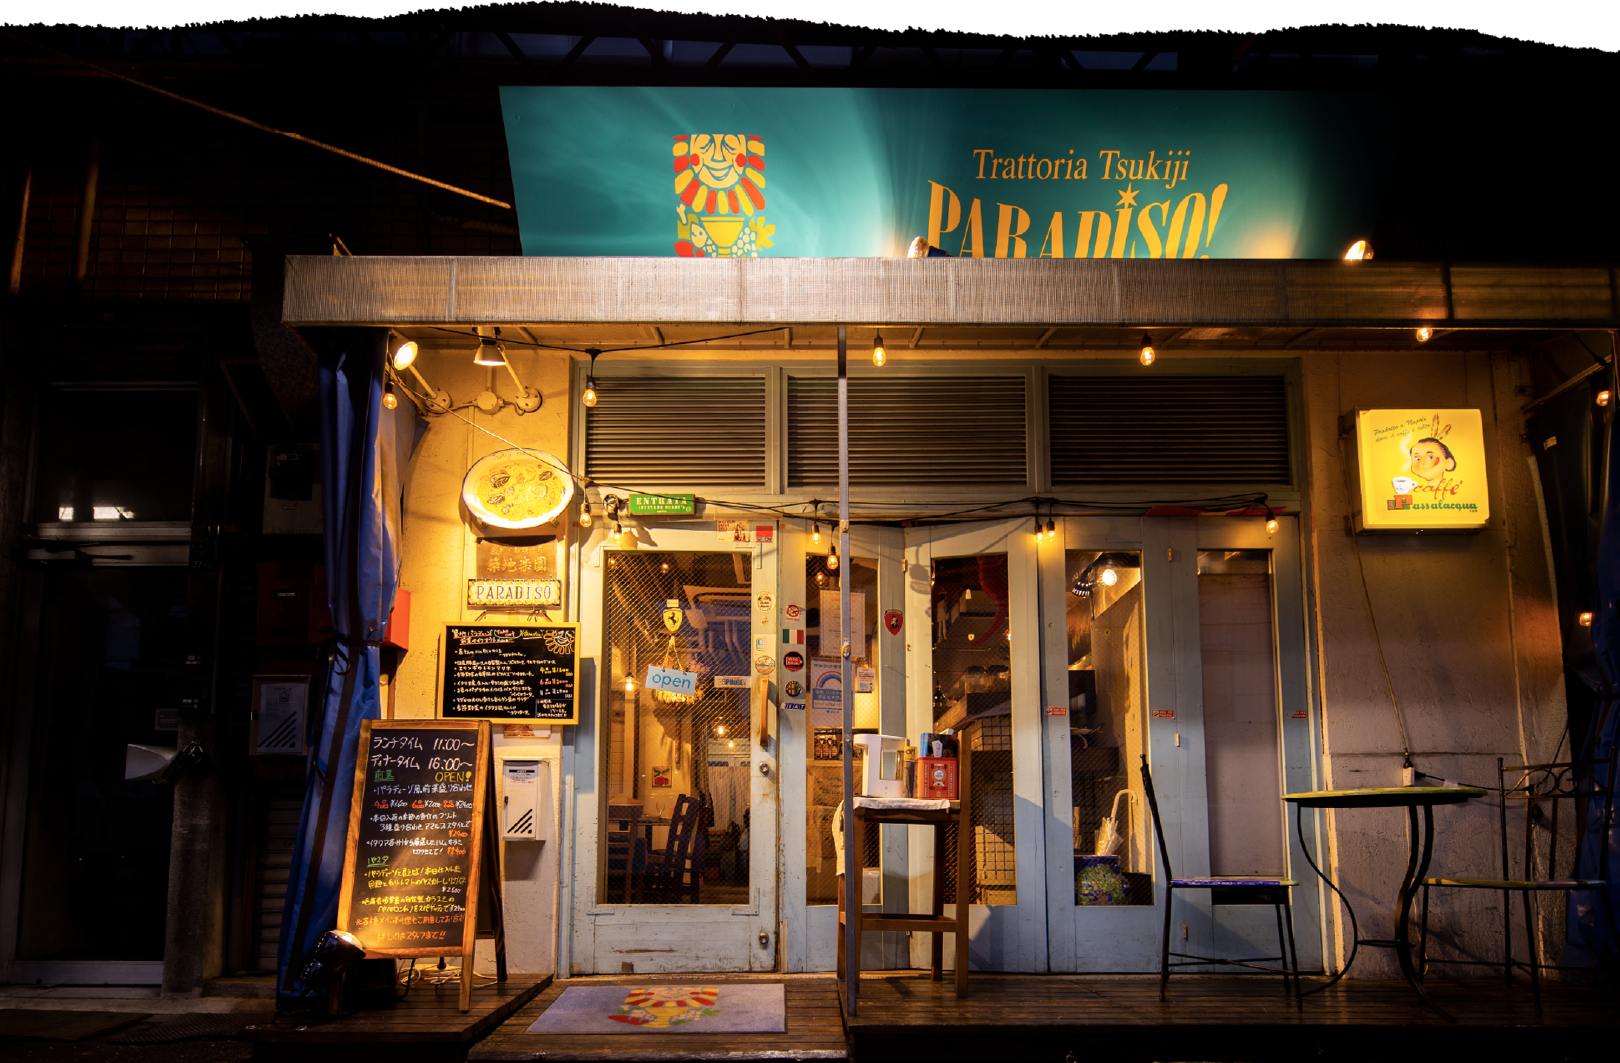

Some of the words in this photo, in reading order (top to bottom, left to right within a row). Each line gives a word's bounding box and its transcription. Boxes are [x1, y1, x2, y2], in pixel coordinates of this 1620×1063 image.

[972, 149, 1088, 180] Trattoria
[1099, 150, 1191, 189] Tsukiji
[477, 586, 551, 600] PARADISO
[652, 673, 691, 689] open
[374, 736, 423, 751] ランチタイム
[371, 754, 420, 770] ディナータイム
[435, 771, 472, 782] OPEN!
